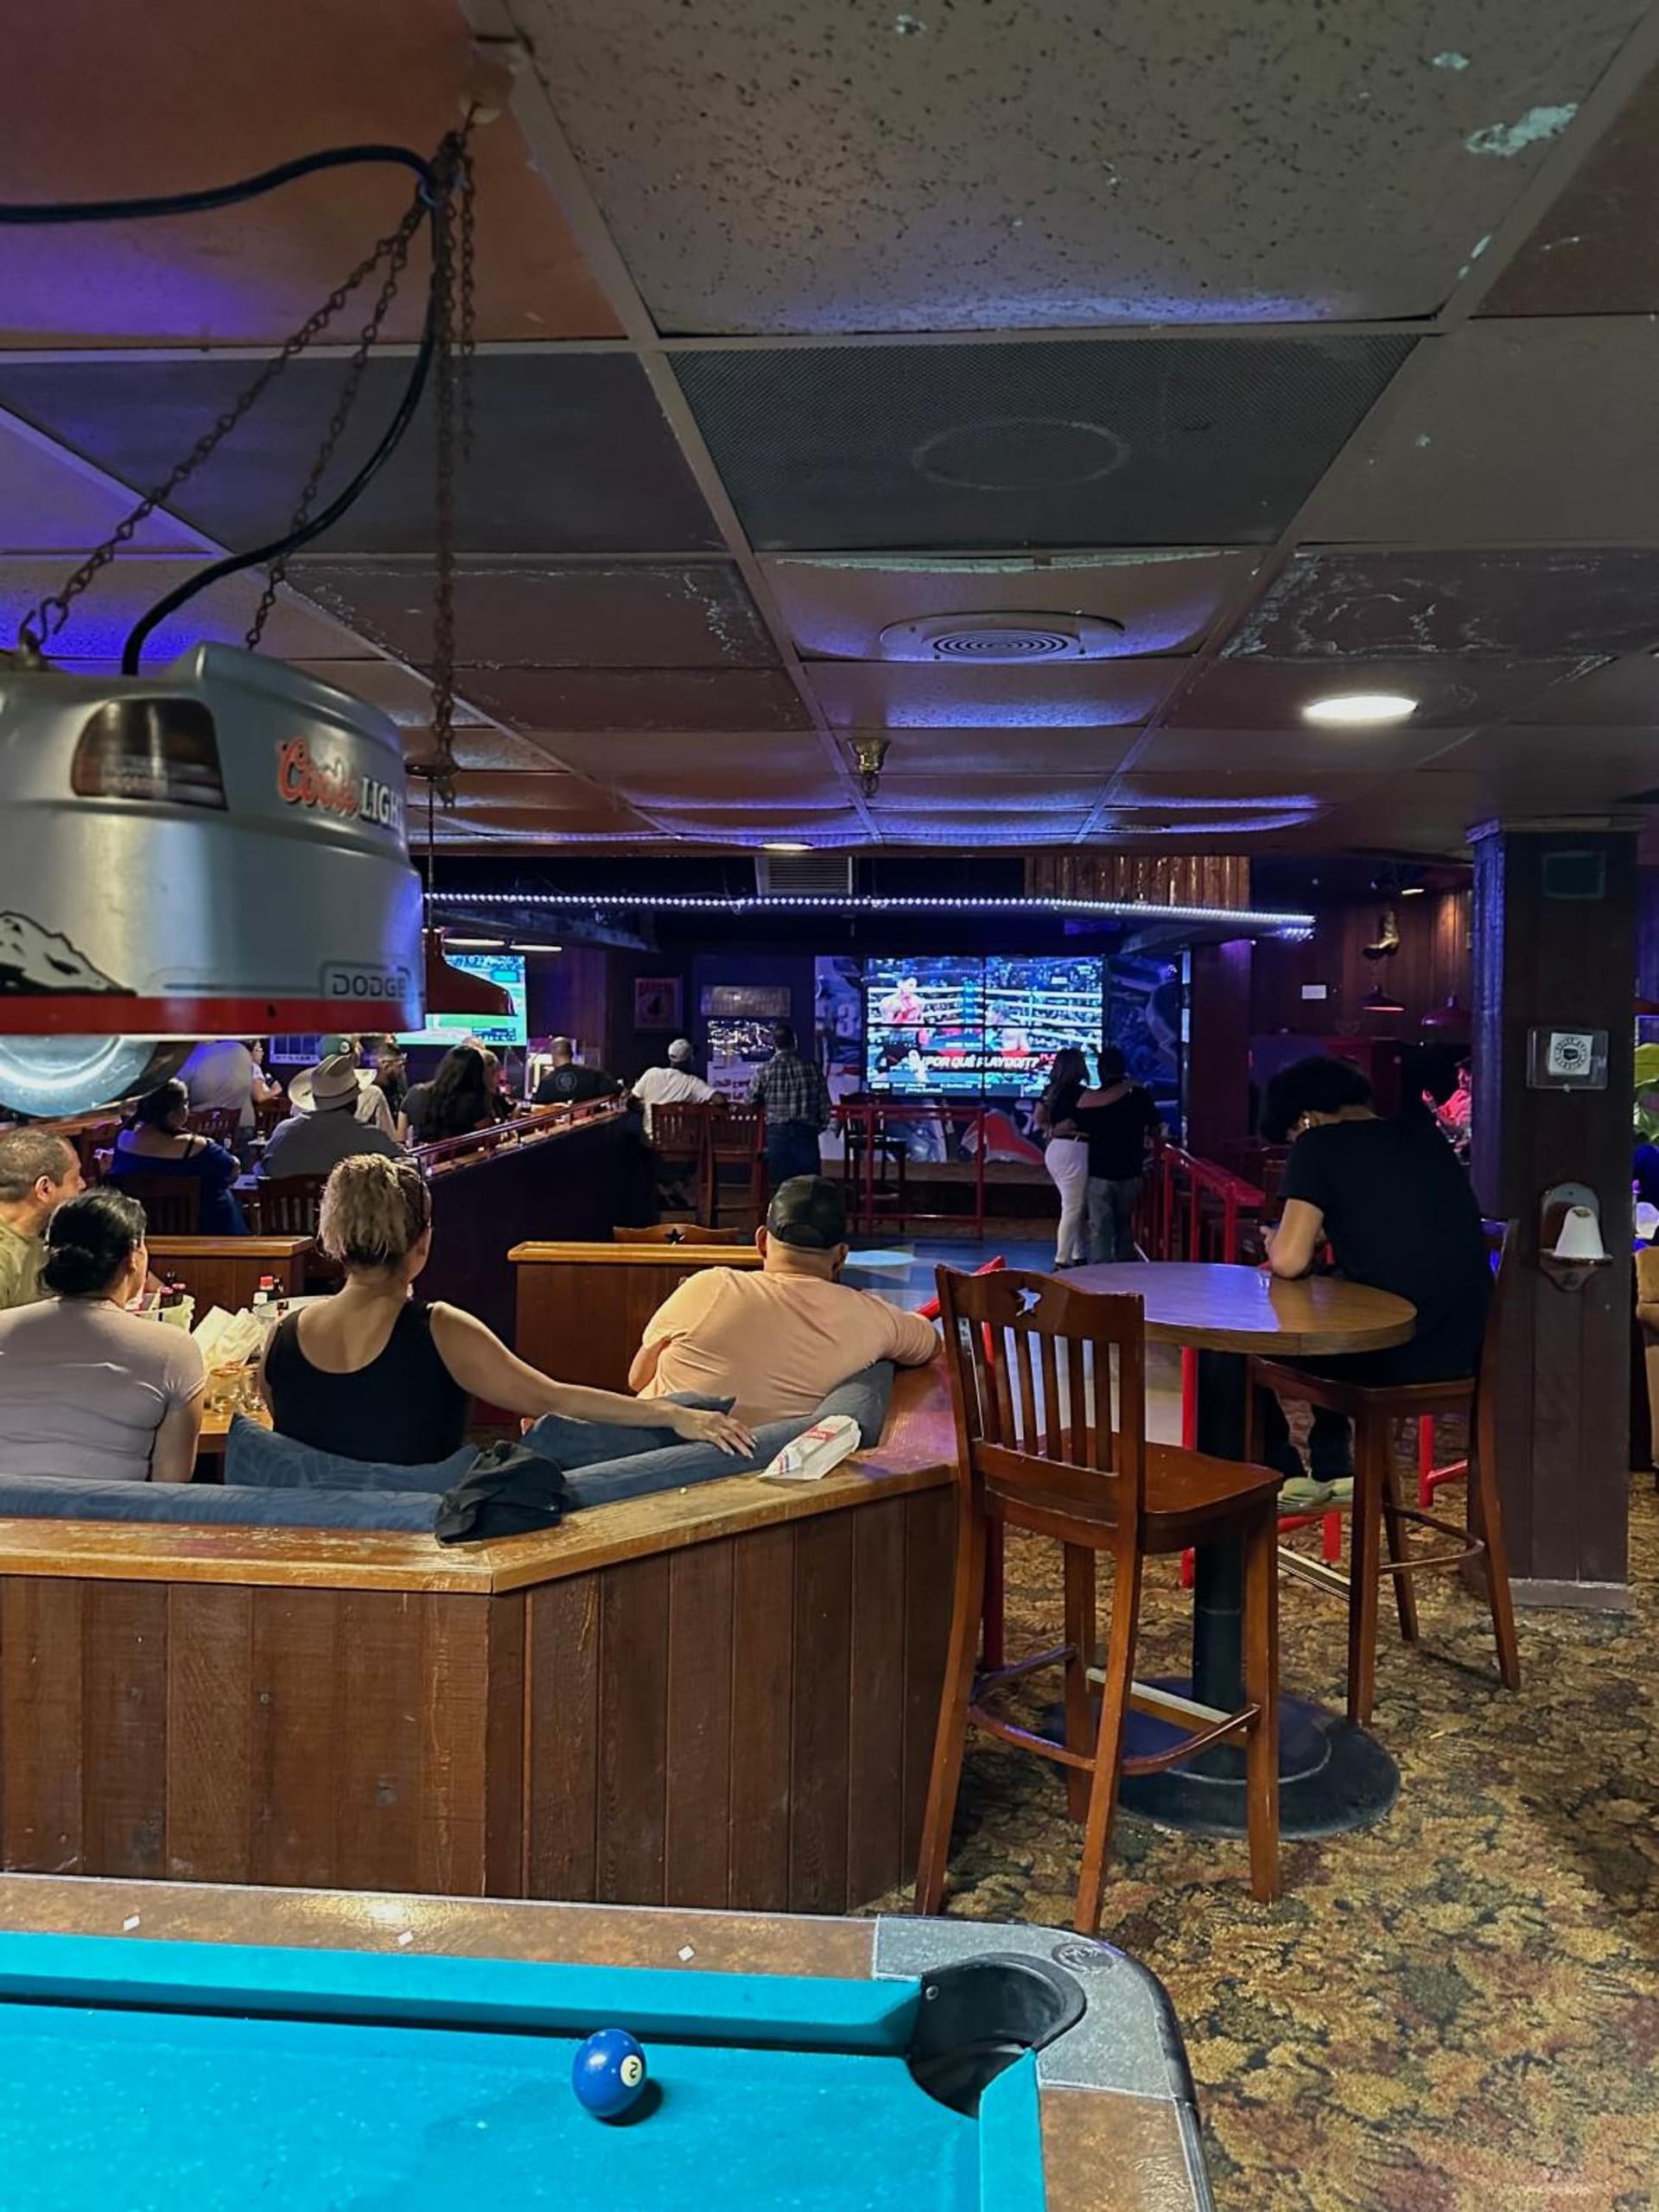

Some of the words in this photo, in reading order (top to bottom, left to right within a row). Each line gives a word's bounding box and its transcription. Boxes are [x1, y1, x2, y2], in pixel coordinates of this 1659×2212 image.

[360, 776, 403, 827] LIGH
[332, 974, 406, 998] DODGE
[629, 2061, 639, 2079] 2
